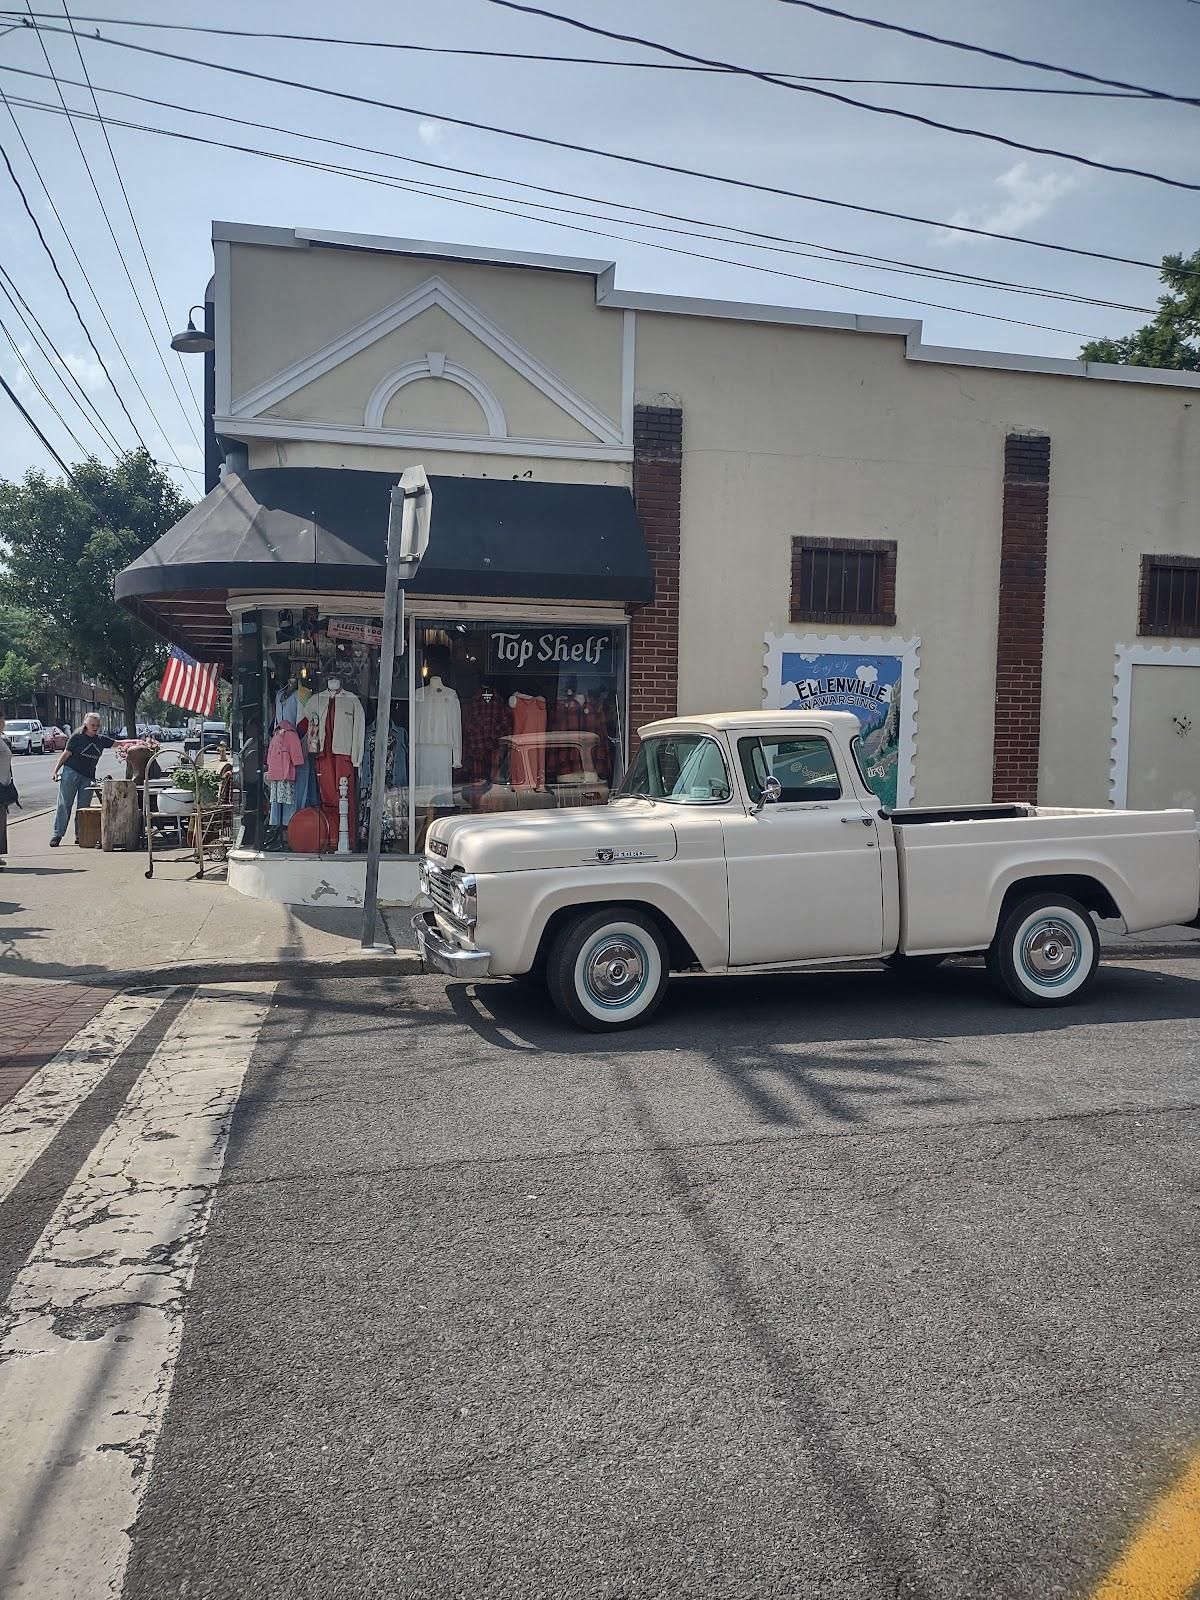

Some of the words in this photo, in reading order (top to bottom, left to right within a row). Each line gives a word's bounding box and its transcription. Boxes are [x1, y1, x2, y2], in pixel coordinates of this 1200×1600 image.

[490, 632, 534, 668] Top
[536, 633, 609, 665] Shelf
[794, 676, 889, 703] ELLENVILLE
